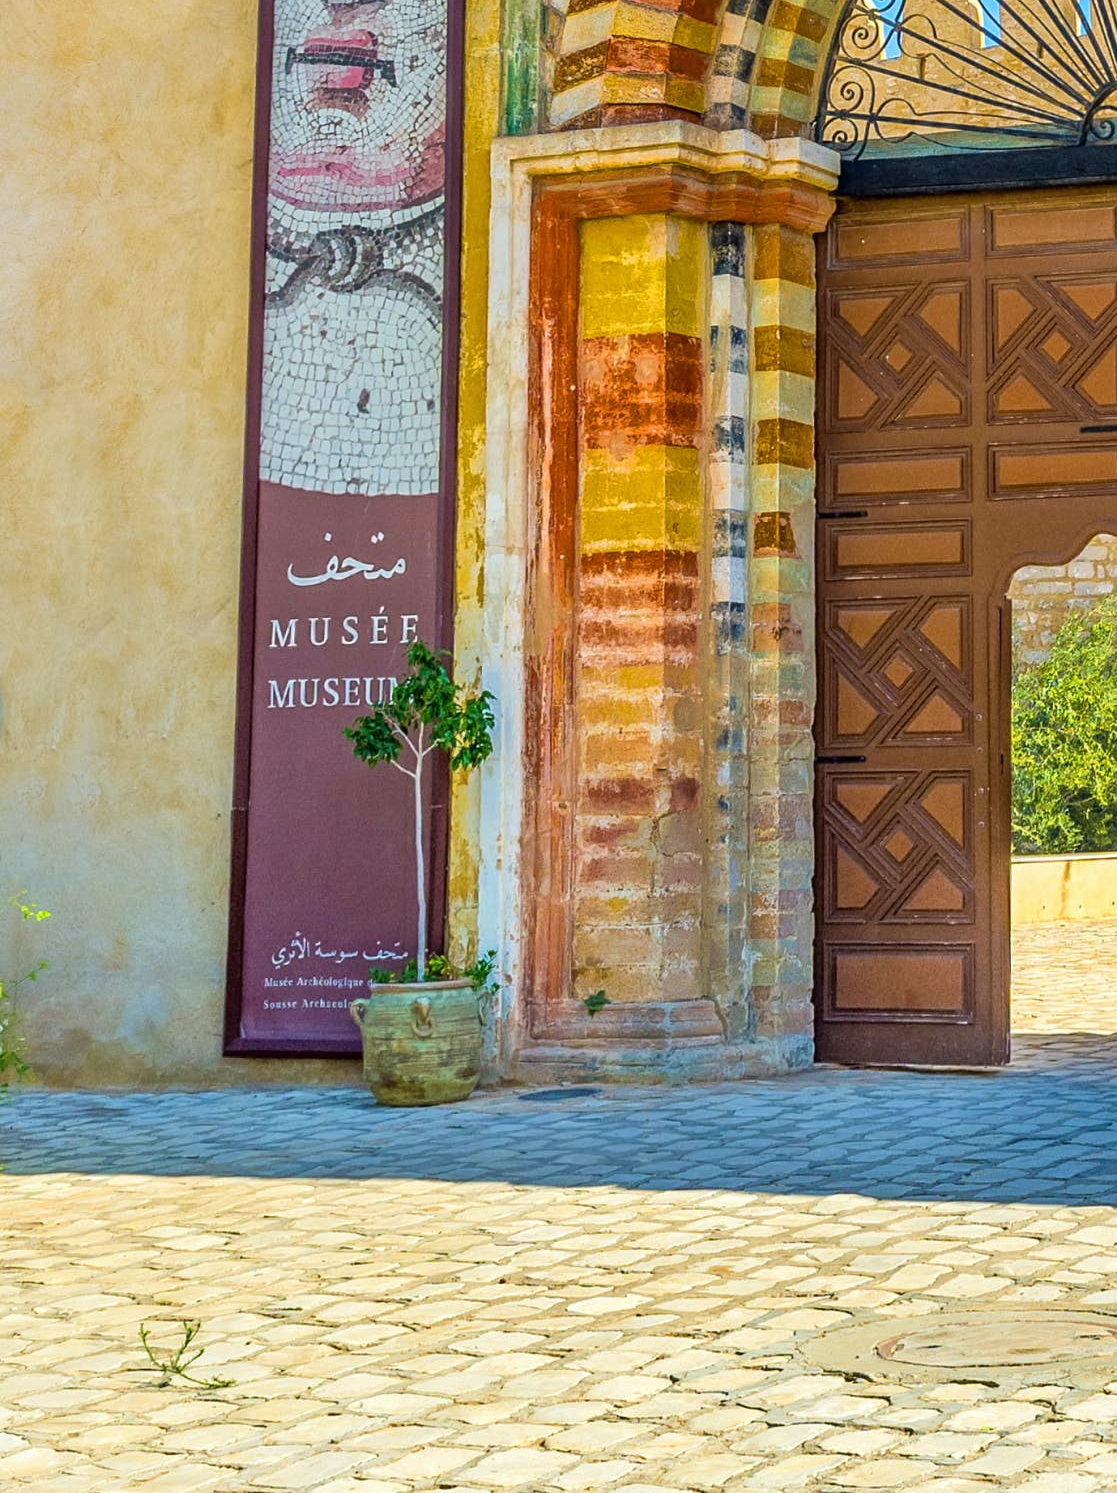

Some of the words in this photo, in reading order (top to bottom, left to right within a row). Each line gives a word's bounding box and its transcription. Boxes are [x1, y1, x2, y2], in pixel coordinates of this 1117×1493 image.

[286, 532, 407, 587] متحف
[268, 606, 419, 648] MUSÉE
[314, 940, 359, 964] سوسة
[296, 976, 365, 989] Archéologique
[263, 999, 298, 1010] Sousse
